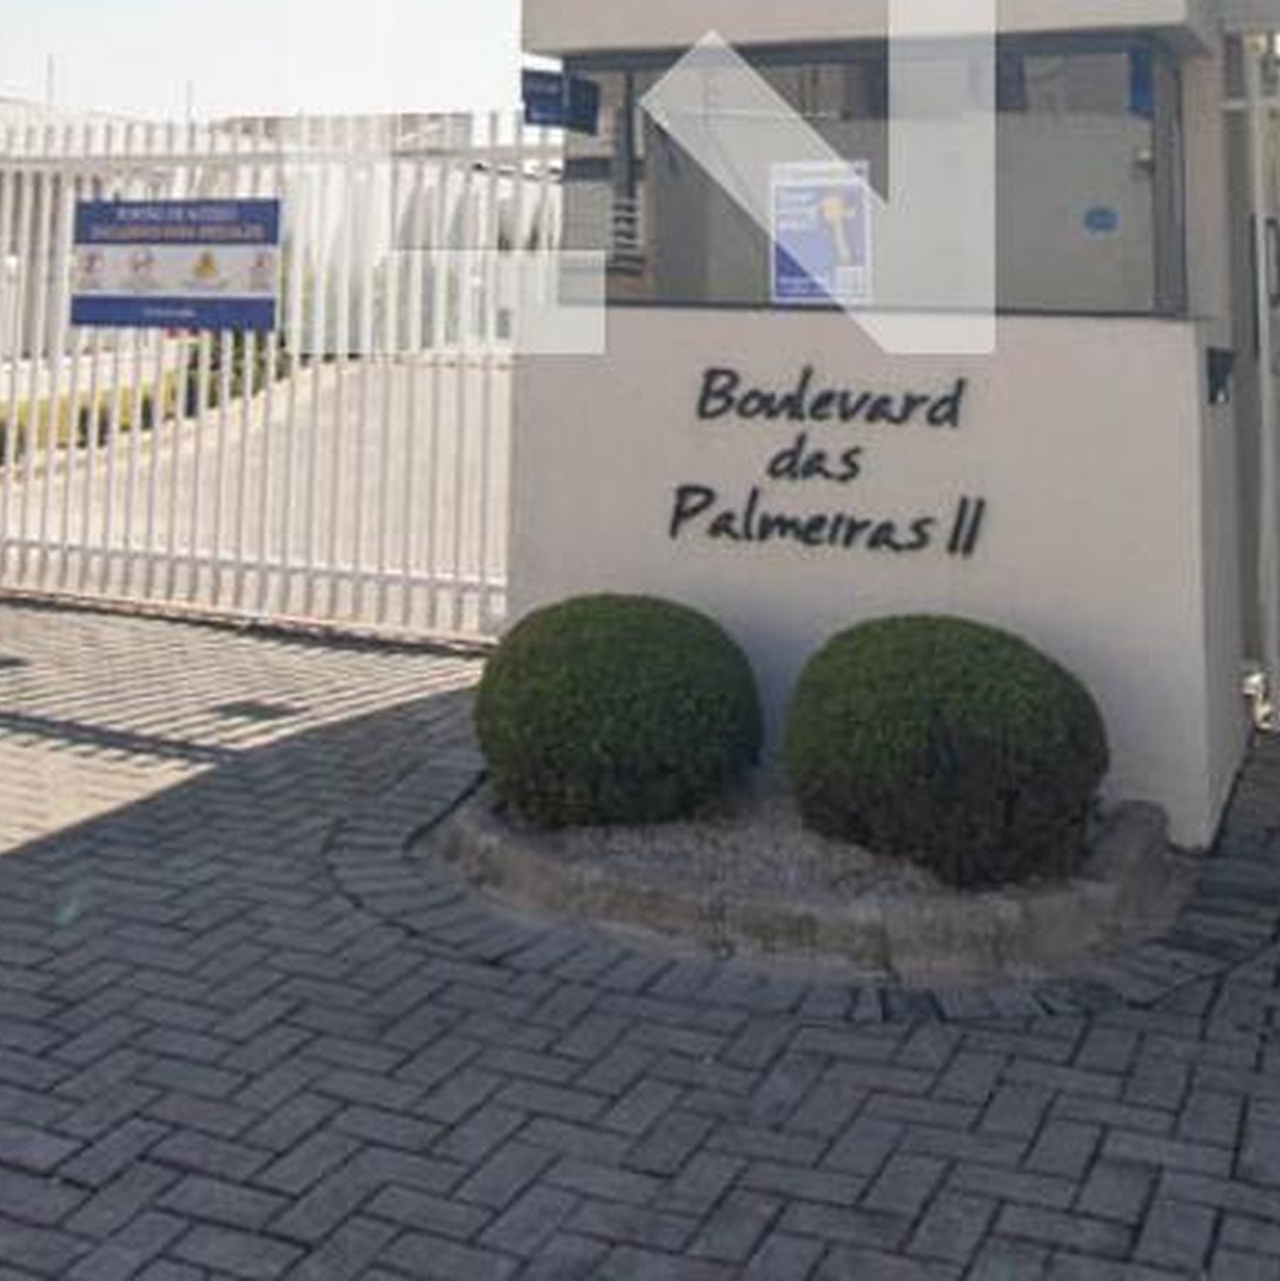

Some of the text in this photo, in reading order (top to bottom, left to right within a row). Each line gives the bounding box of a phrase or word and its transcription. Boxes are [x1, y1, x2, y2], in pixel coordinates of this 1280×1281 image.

[696, 365, 967, 428] Boulevard
[767, 431, 863, 483] das
[668, 484, 934, 553] Palmeiras
